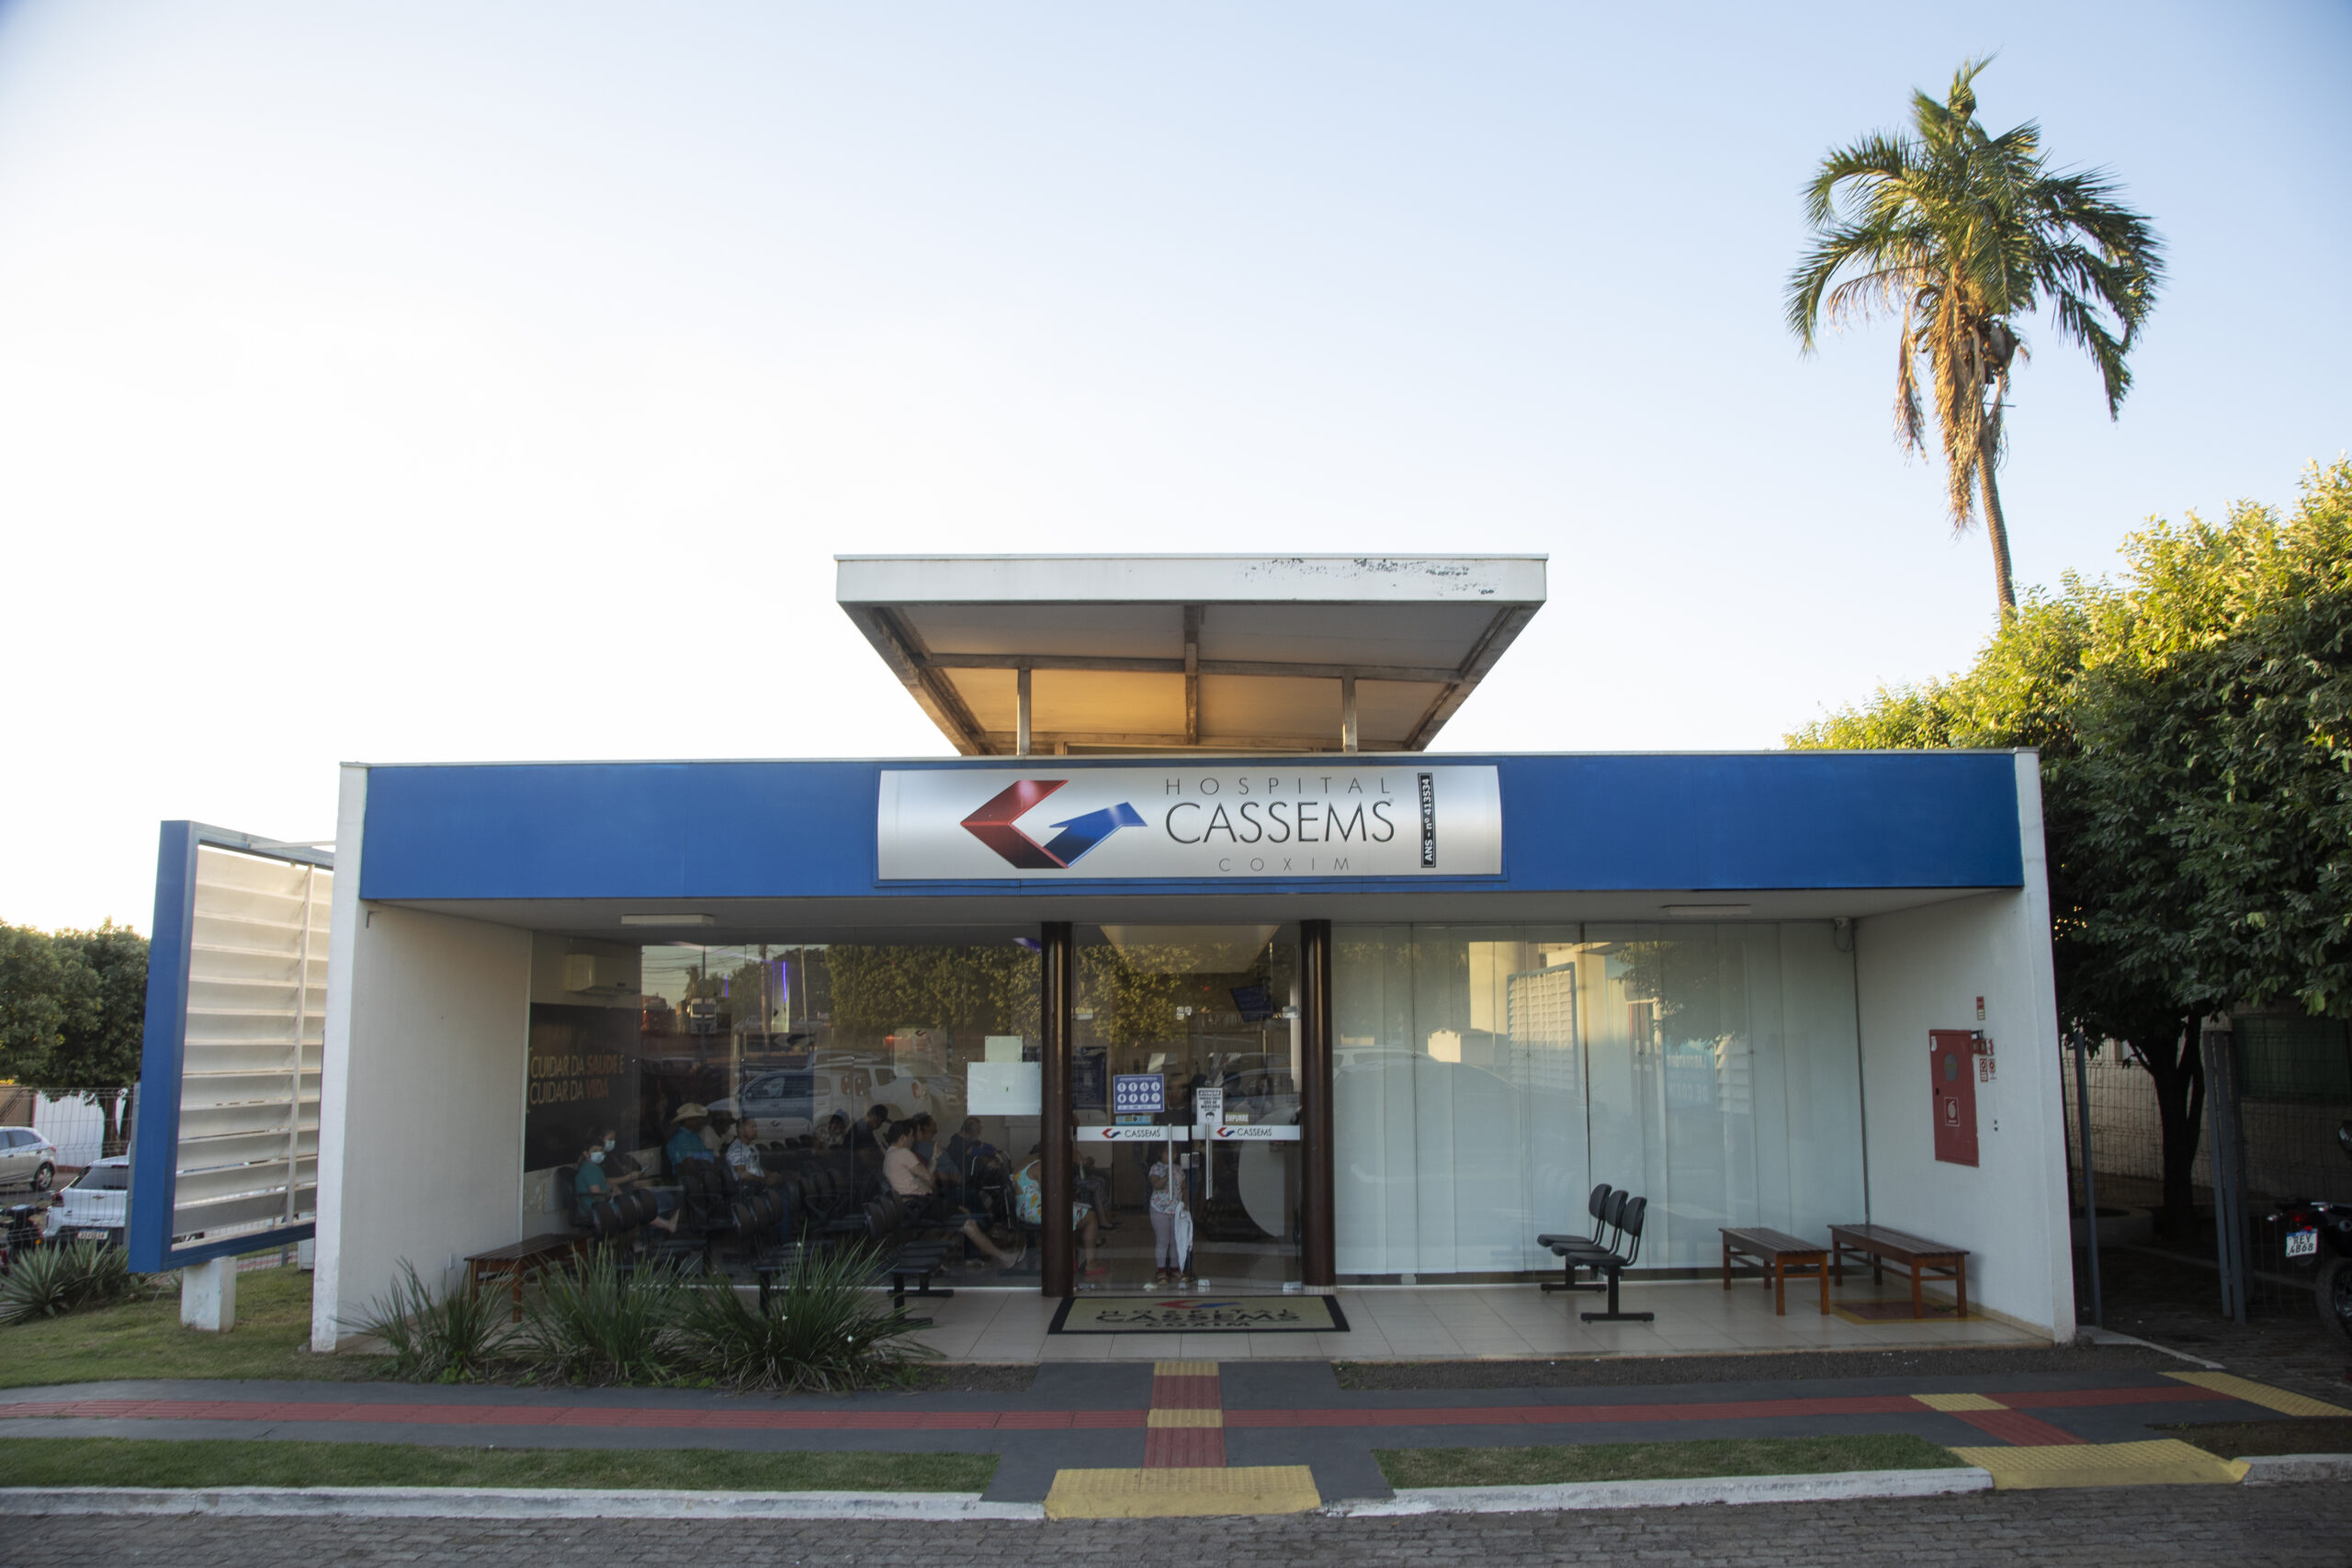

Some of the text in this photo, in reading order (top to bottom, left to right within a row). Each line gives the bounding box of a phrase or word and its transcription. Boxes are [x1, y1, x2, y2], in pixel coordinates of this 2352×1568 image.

[1166, 777, 1390, 795] HOSPITAL
[1422, 778, 1432, 816] 413534
[1166, 801, 1395, 844] CASSEMS
[1219, 857, 1349, 872] COXIM
[531, 1055, 569, 1079] CUIDAR
[571, 1055, 584, 1077] DA
[529, 1077, 609, 1105] CUIDAR DA VIDA
[1125, 1129, 1161, 1138] CASSEMS
[1237, 1128, 1272, 1137] CASSEMS
[1096, 1313, 1301, 1322] CASSEMS
